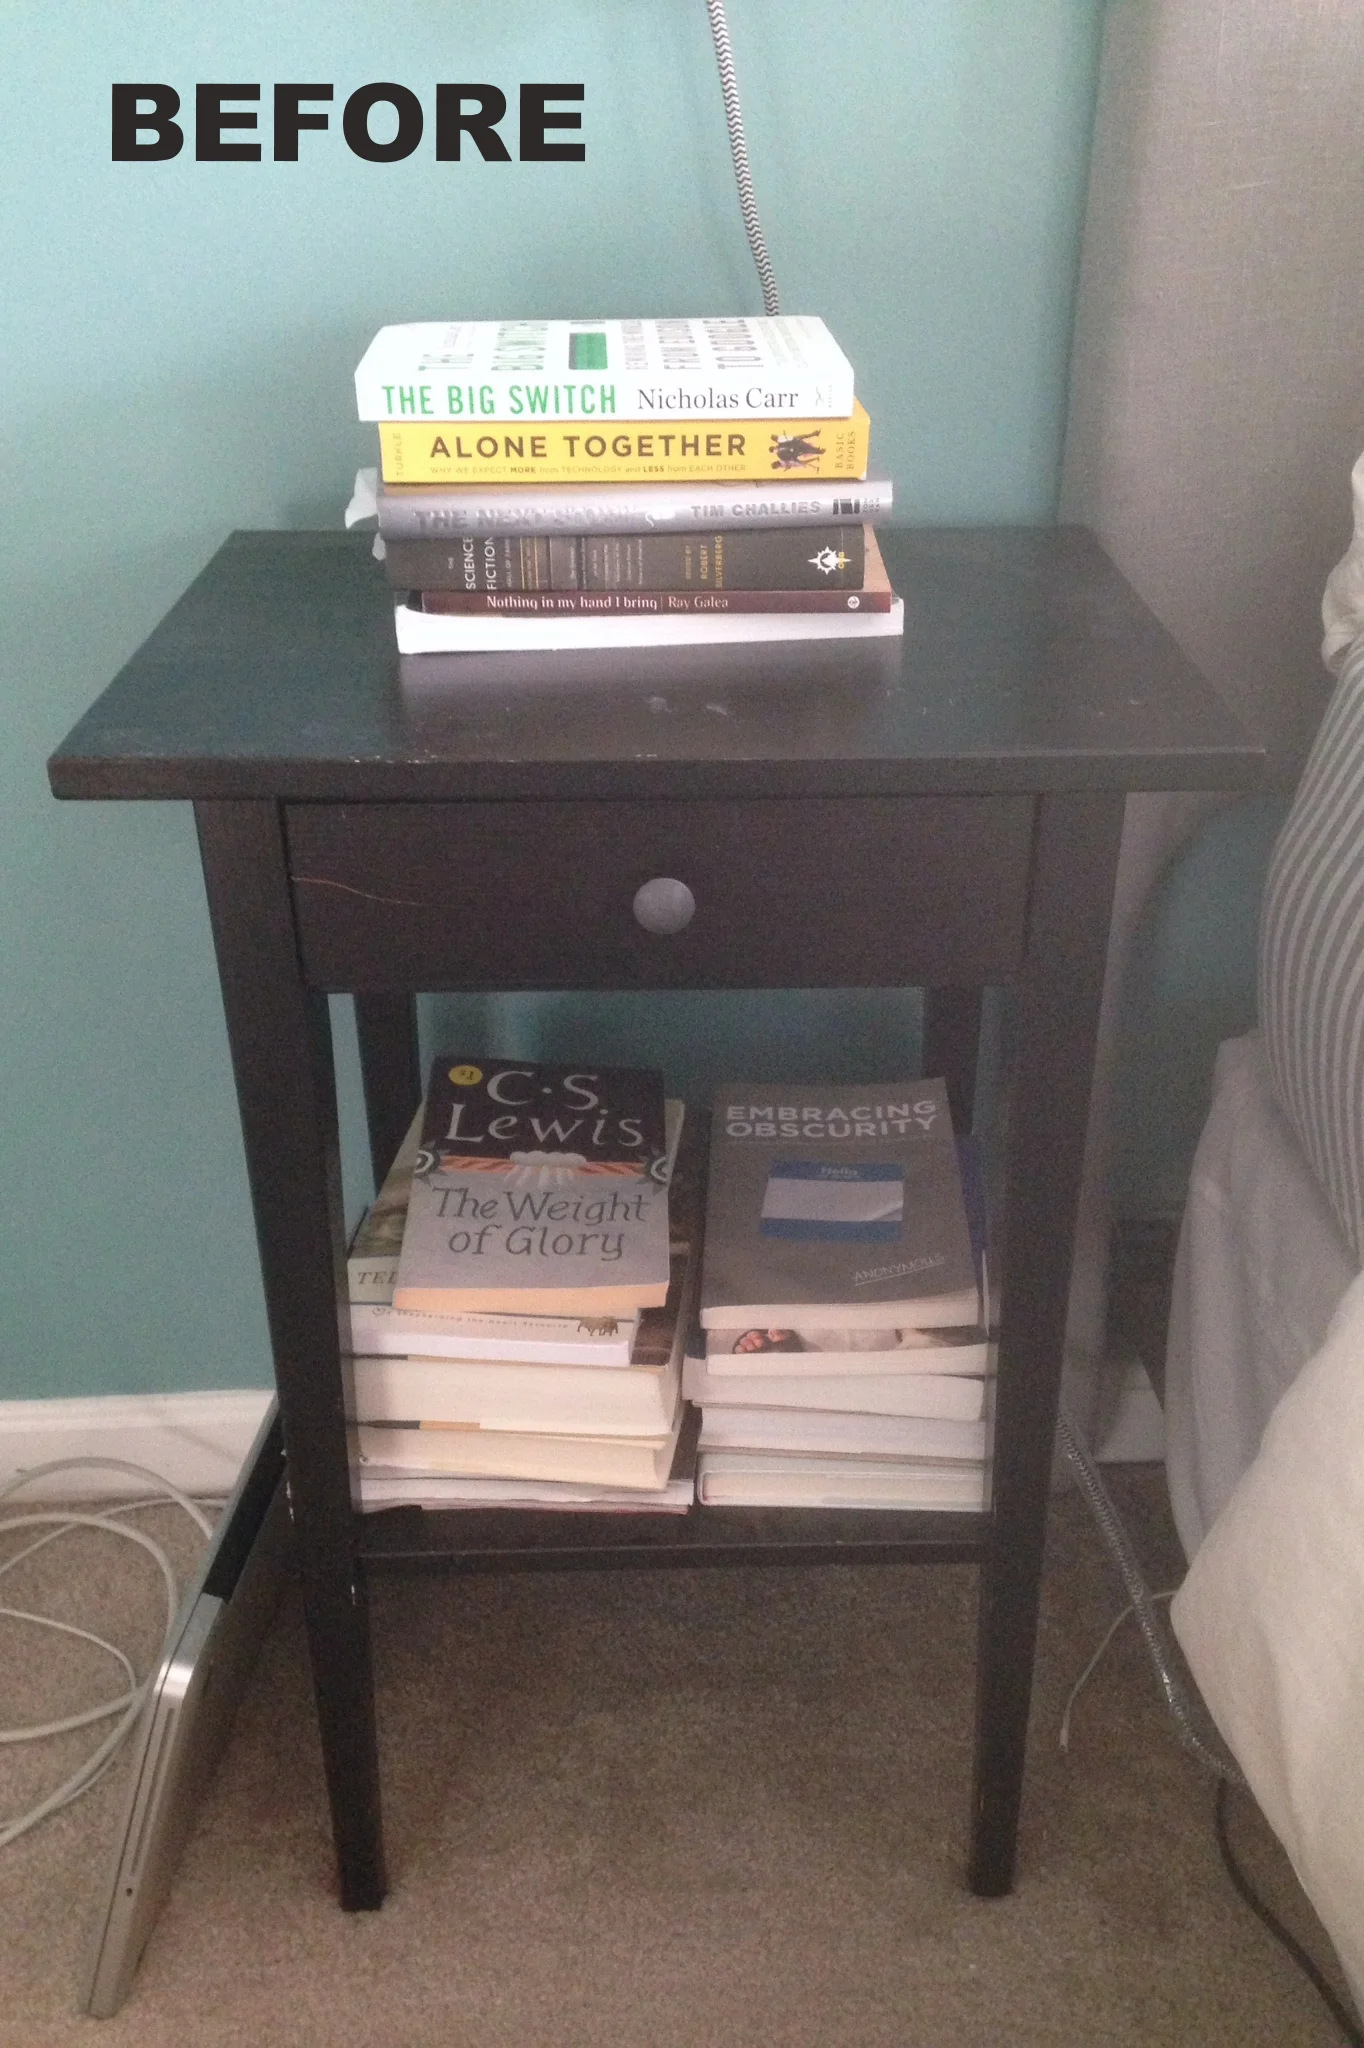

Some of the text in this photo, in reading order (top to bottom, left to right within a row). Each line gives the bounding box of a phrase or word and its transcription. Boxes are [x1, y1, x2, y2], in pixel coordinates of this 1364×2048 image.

[381, 384, 616, 415] THE BIG SWITCH
[637, 387, 799, 410] Nicholas Carr
[392, 432, 404, 476] TURKLE
[430, 433, 746, 458] ALONE TOGETHER
[835, 432, 845, 469] BASIC
[846, 430, 856, 470] BOOKS
[430, 463, 746, 474] WHY WE EXPECT MORE from TECHNOLOGY and LESS from EACH OTHER
[690, 501, 822, 518] TIM CHALLIES
[462, 536, 477, 590] SCIENCE
[700, 544, 708, 580] ROBERT
[714, 535, 723, 588] SILVERBERG
[486, 595, 658, 611] Nothing in my hand I bring
[668, 595, 729, 610] Ray Galea
[443, 1102, 644, 1147] Lewis
[725, 1115, 938, 1138] OBSCURITY
[726, 1100, 938, 1122] EMBRACING
[432, 1187, 653, 1227] The Weight
[448, 1224, 627, 1262] of Glory
